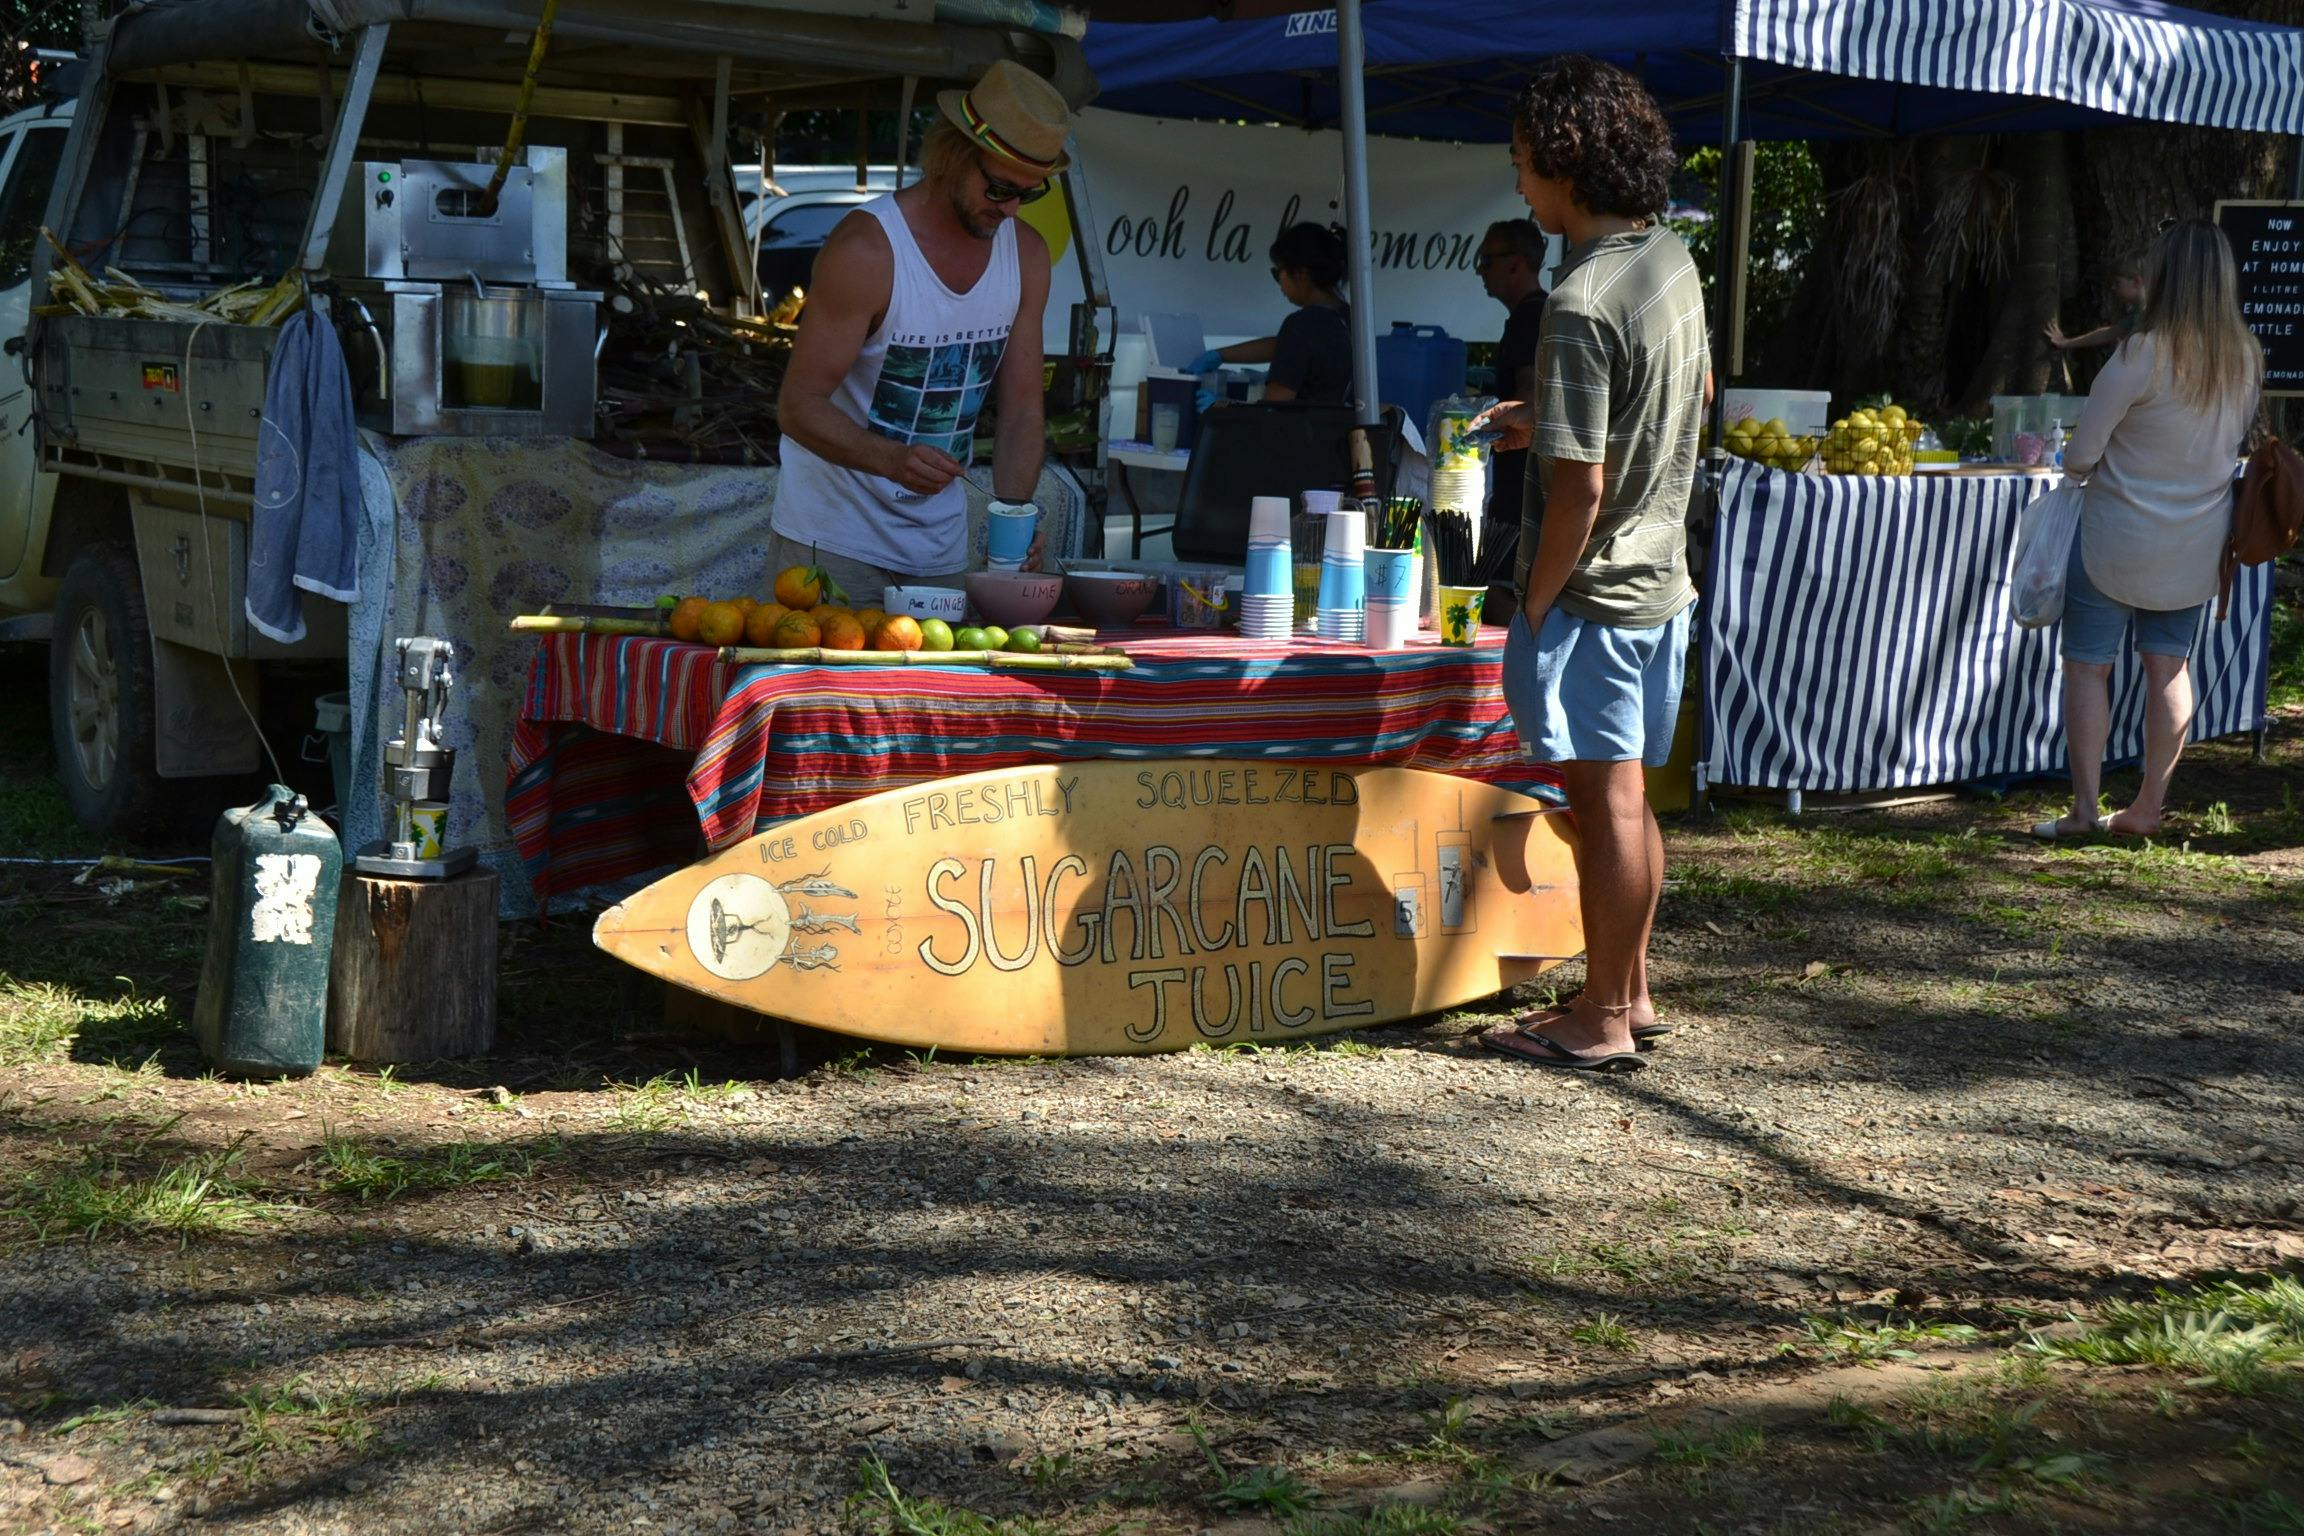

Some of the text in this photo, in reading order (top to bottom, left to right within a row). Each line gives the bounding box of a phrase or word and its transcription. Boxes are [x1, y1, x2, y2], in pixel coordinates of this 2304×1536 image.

[1106, 185, 1189, 260] ooh
[1205, 189, 1252, 263] la
[2267, 218, 2293, 231] NOW
[2251, 240, 2301, 252] ENJOY
[2242, 261, 2304, 274] AT HOM
[2262, 285, 2299, 294] LITRE
[2243, 302, 2304, 315] EMONAD
[891, 324, 1011, 344] LIFE IS BETTER
[2249, 323, 2293, 336] OTTLE
[1022, 584, 1057, 600] LIME
[760, 768, 1360, 864] ICE COLD FRESHLY SQUEEZED
[918, 843, 1375, 977] SUGARCANE
[1124, 952, 1375, 1044] JUICE
